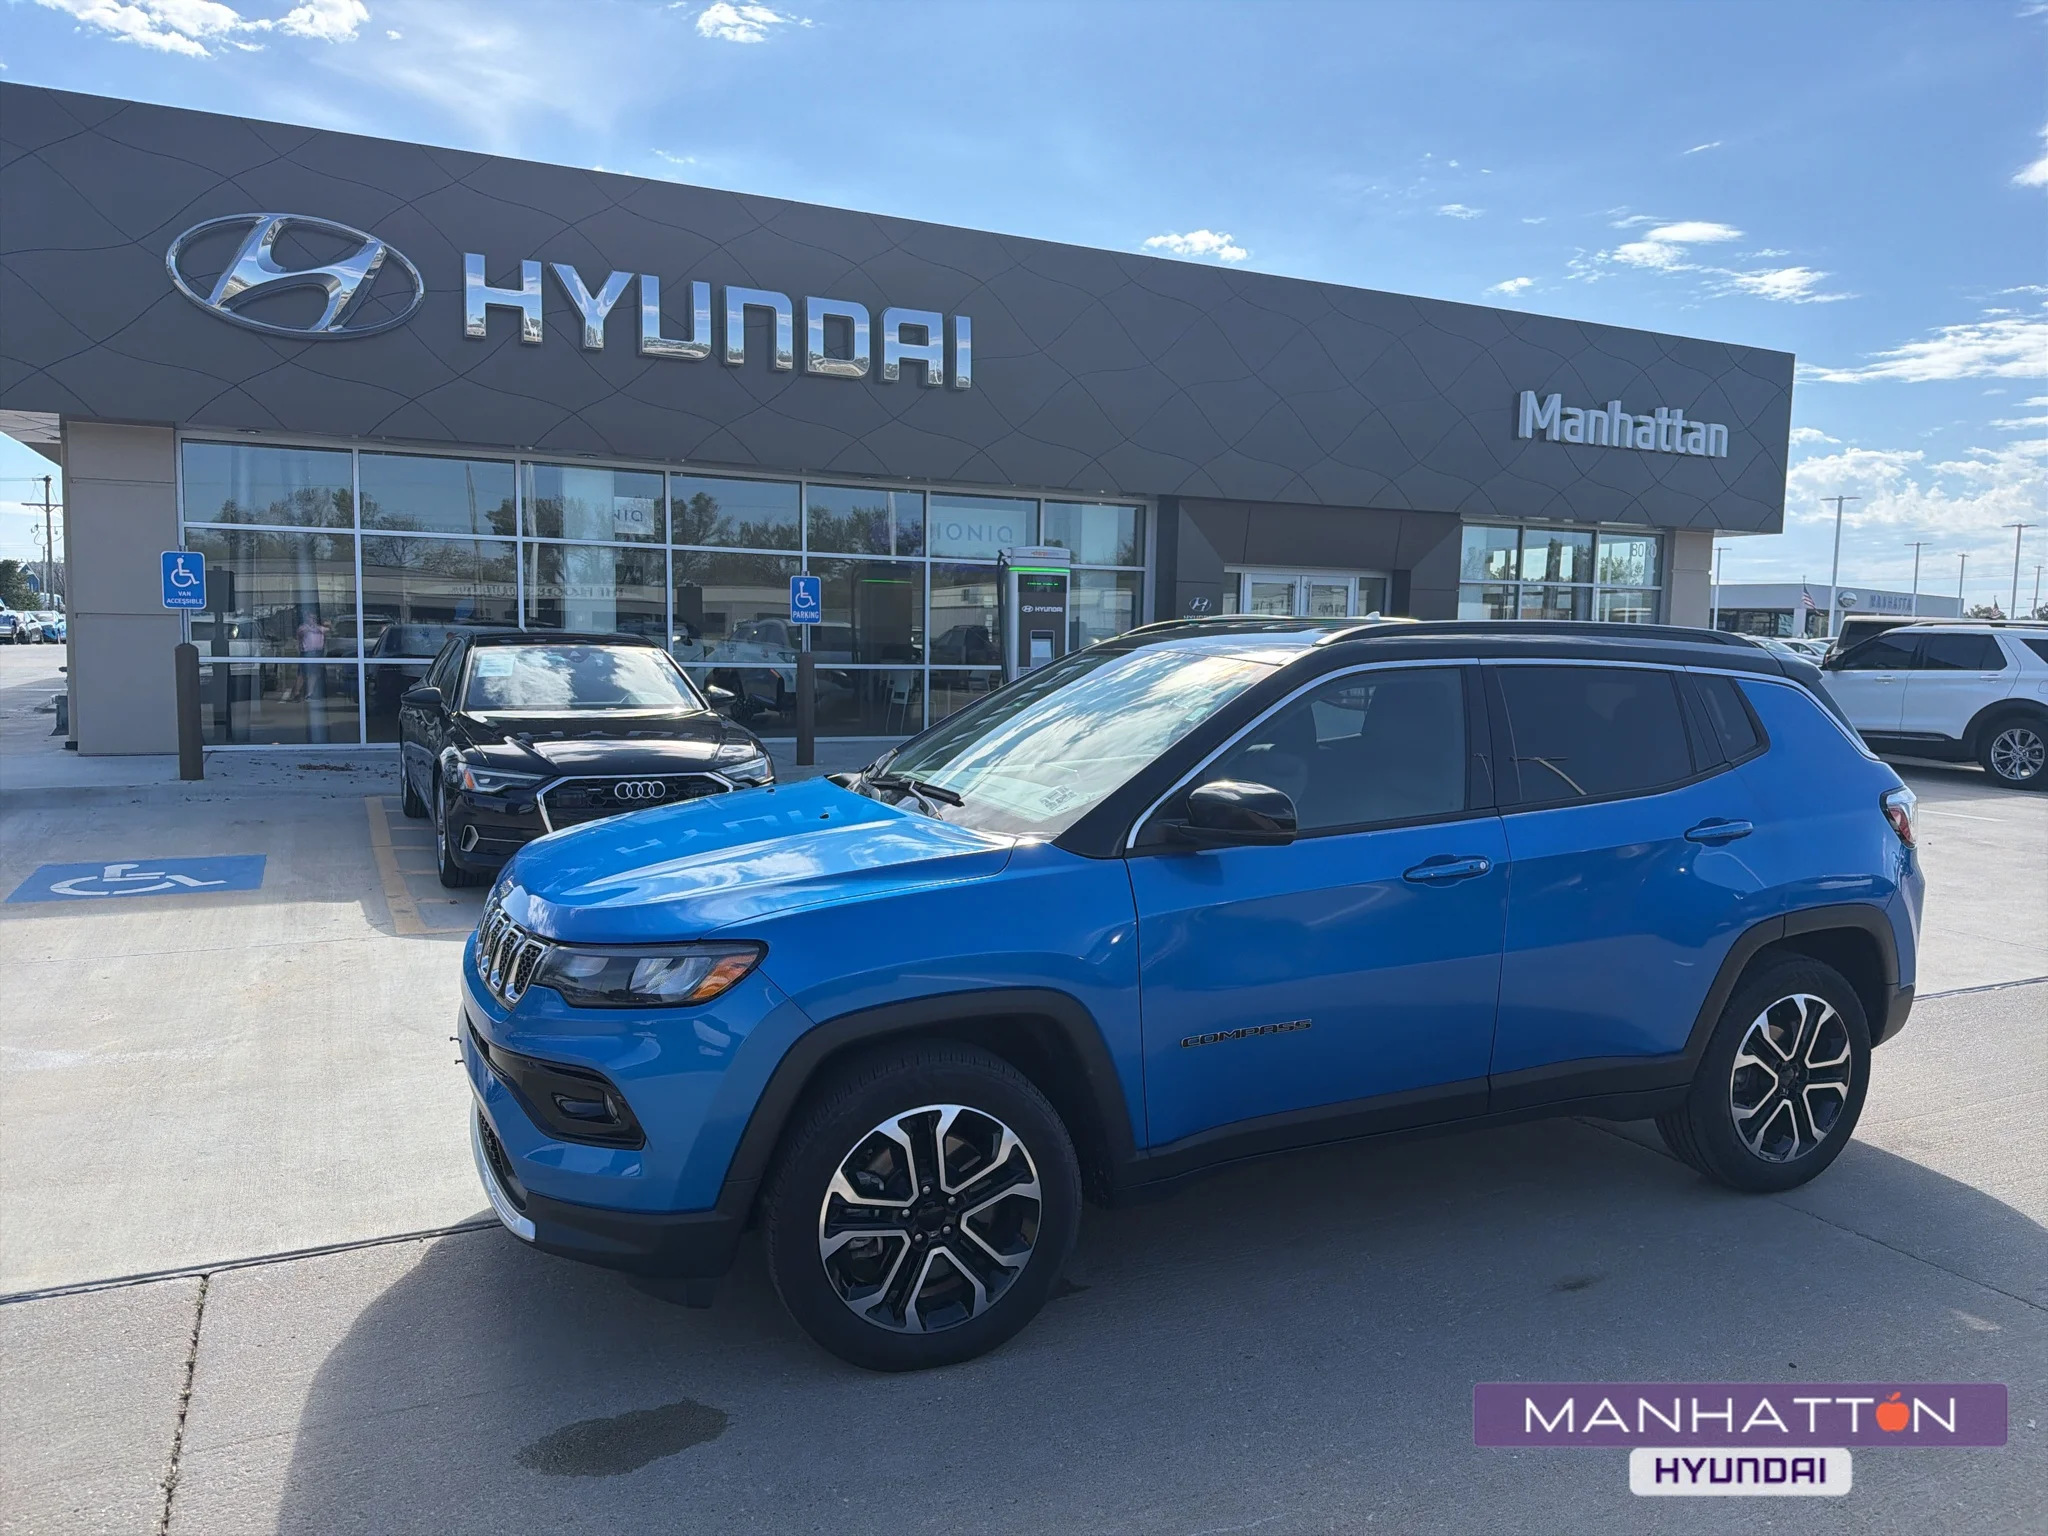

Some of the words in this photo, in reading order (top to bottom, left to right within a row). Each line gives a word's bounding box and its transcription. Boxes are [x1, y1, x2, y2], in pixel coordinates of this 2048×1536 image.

[462, 253, 973, 390] HYUNDAI
[1518, 390, 1729, 458] Manhattan
[937, 522, 1013, 544] IONIQ
[792, 611, 819, 619] PARKING
[1180, 1018, 1312, 1048] COMPASS
